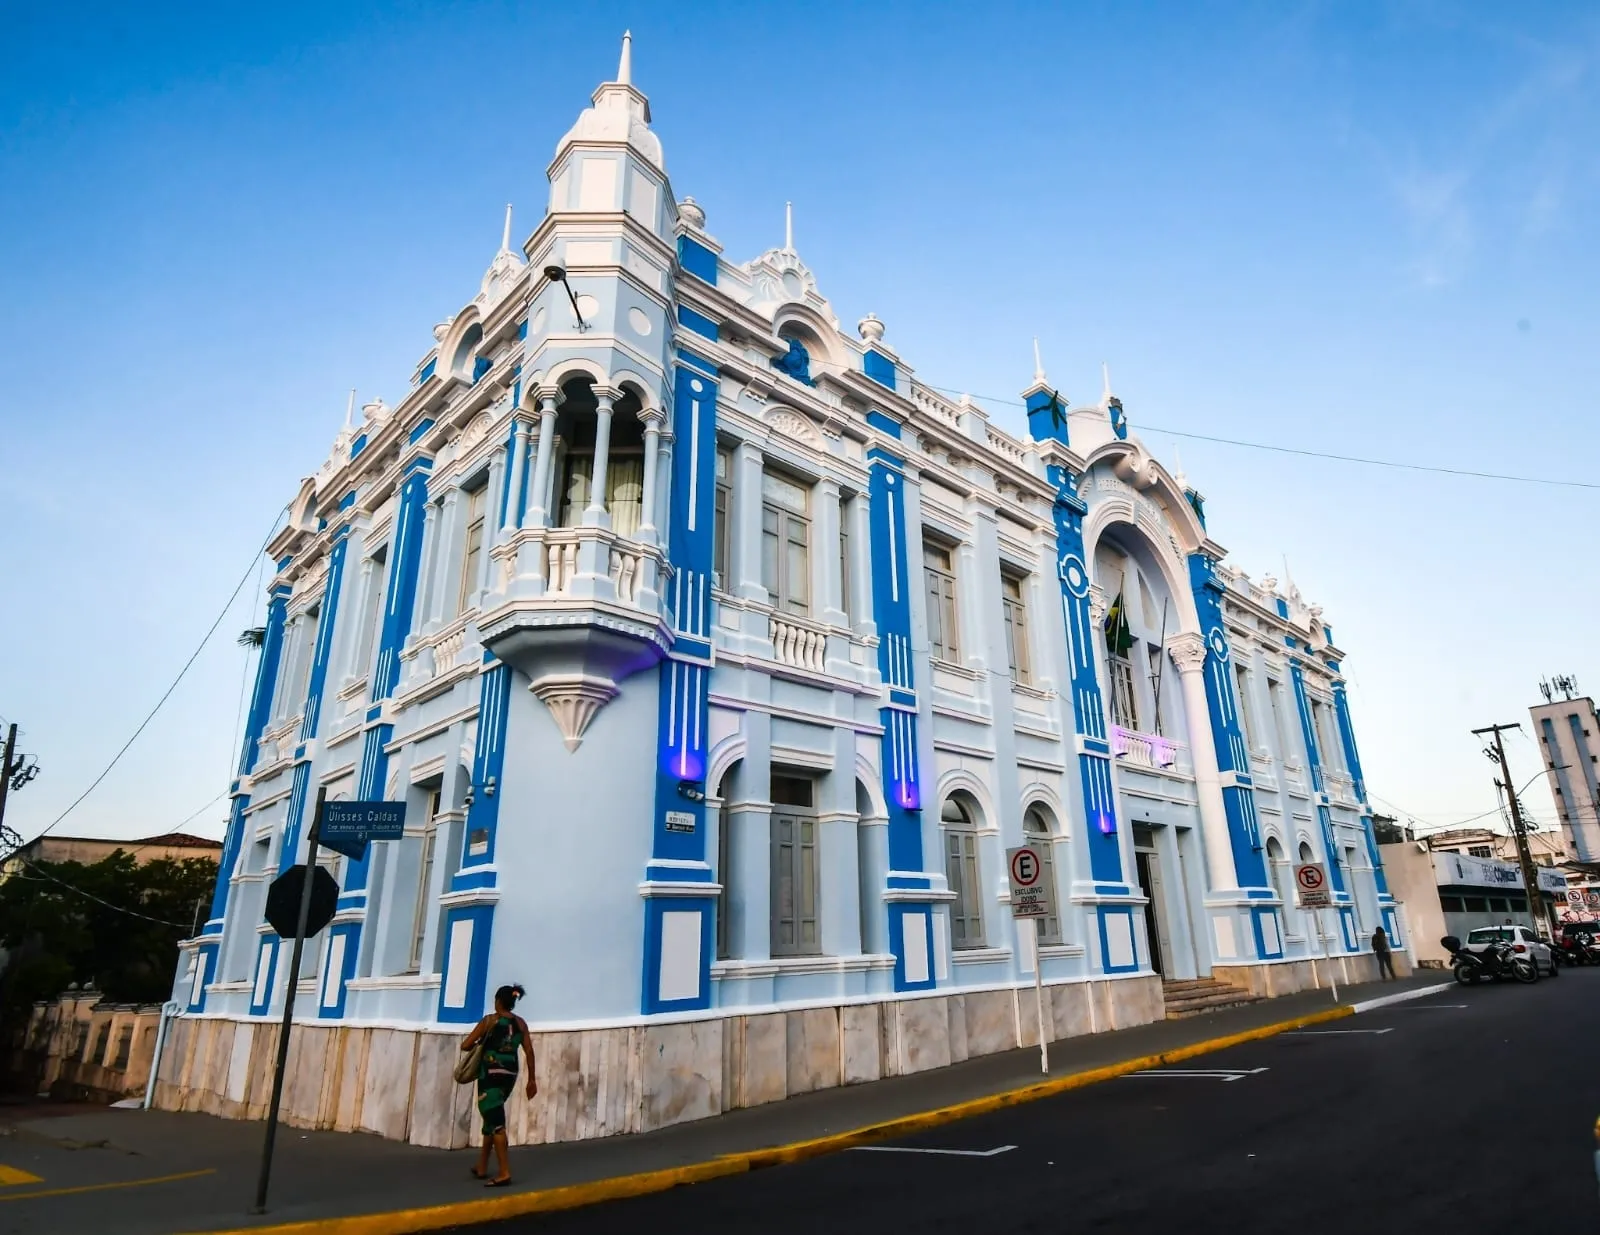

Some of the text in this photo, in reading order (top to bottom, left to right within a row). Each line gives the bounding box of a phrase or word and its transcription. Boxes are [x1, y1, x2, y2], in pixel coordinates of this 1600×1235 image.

[328, 811, 398, 821] Ulisses Caldas
[1020, 856, 1032, 879] E
